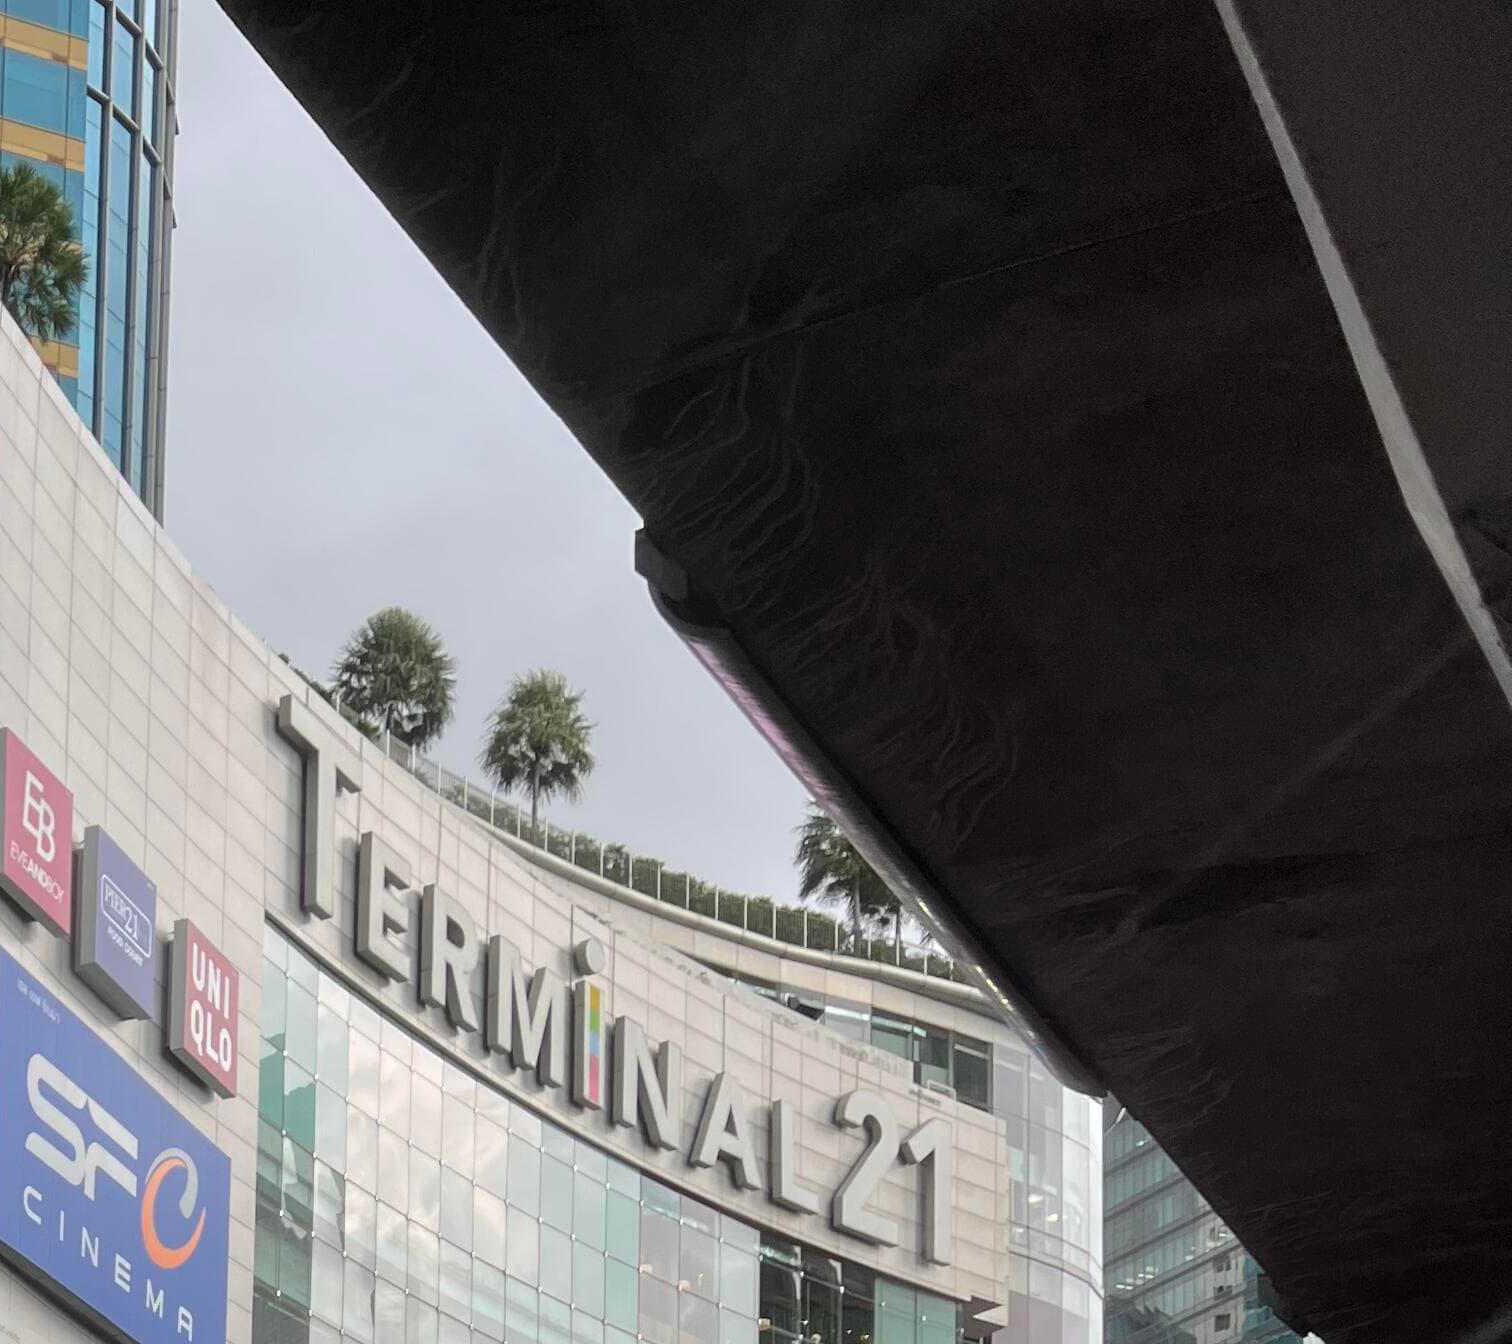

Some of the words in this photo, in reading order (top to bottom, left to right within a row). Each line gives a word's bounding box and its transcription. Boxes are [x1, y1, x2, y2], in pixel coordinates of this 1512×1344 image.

[190, 999, 233, 1073] QLO
[191, 943, 230, 1020] UNI
[832, 1090, 954, 1267] 21
[23, 1186, 194, 1342] CINEMA
